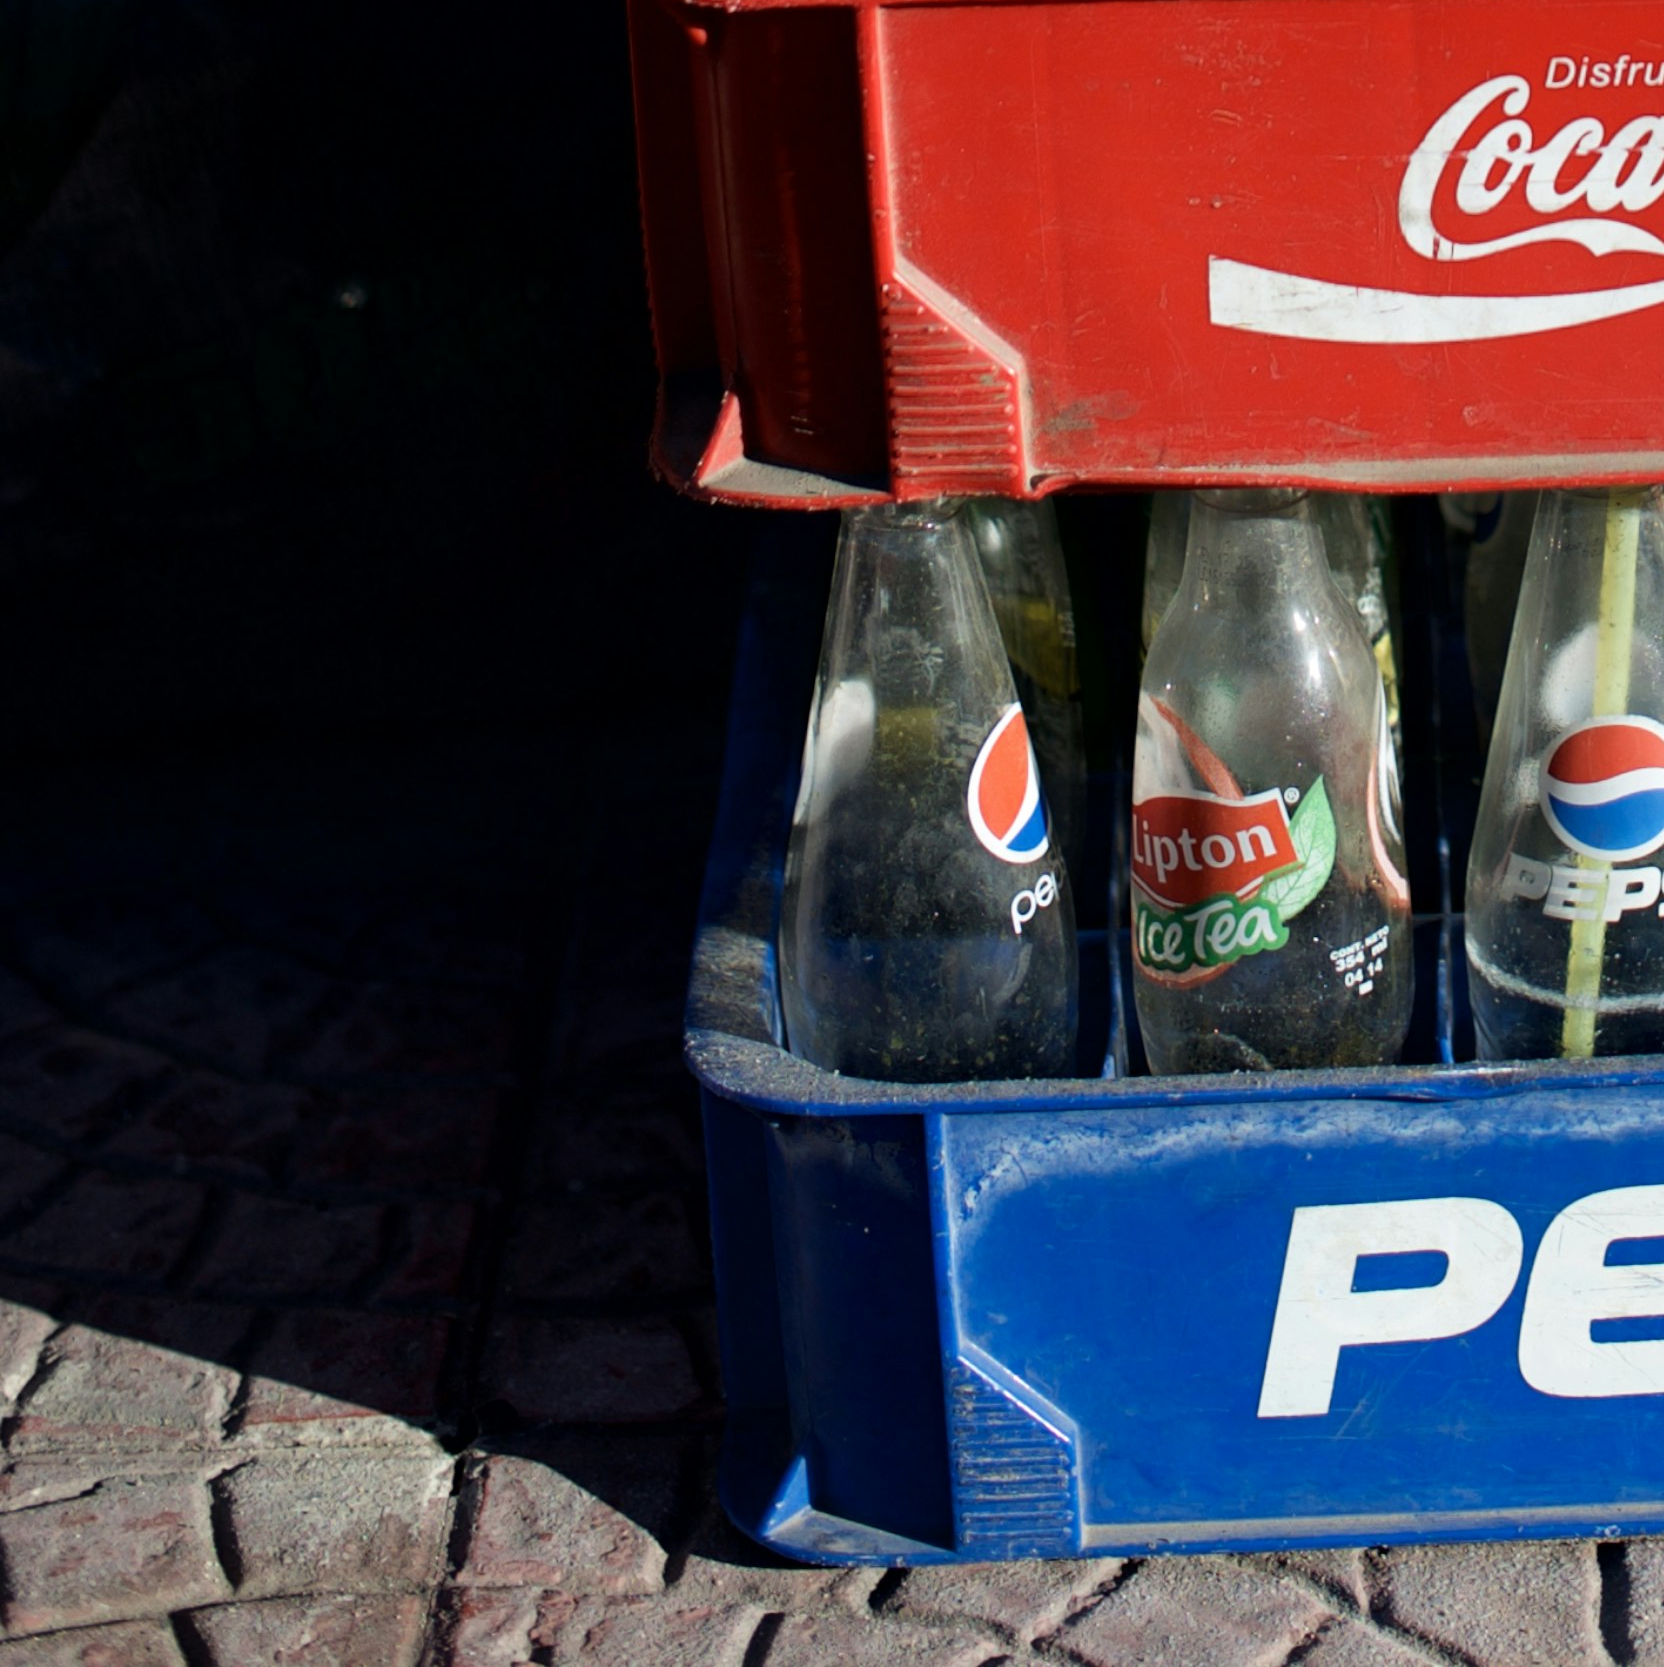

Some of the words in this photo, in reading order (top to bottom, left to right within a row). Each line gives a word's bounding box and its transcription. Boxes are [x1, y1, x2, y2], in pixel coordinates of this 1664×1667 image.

[1133, 813, 1278, 884] Lipton
[1138, 910, 1186, 965] Ice
[1184, 899, 1278, 959] Tea
[1335, 950, 1365, 973] 354
[1344, 967, 1364, 988] 04
[1367, 957, 1383, 977] 14
